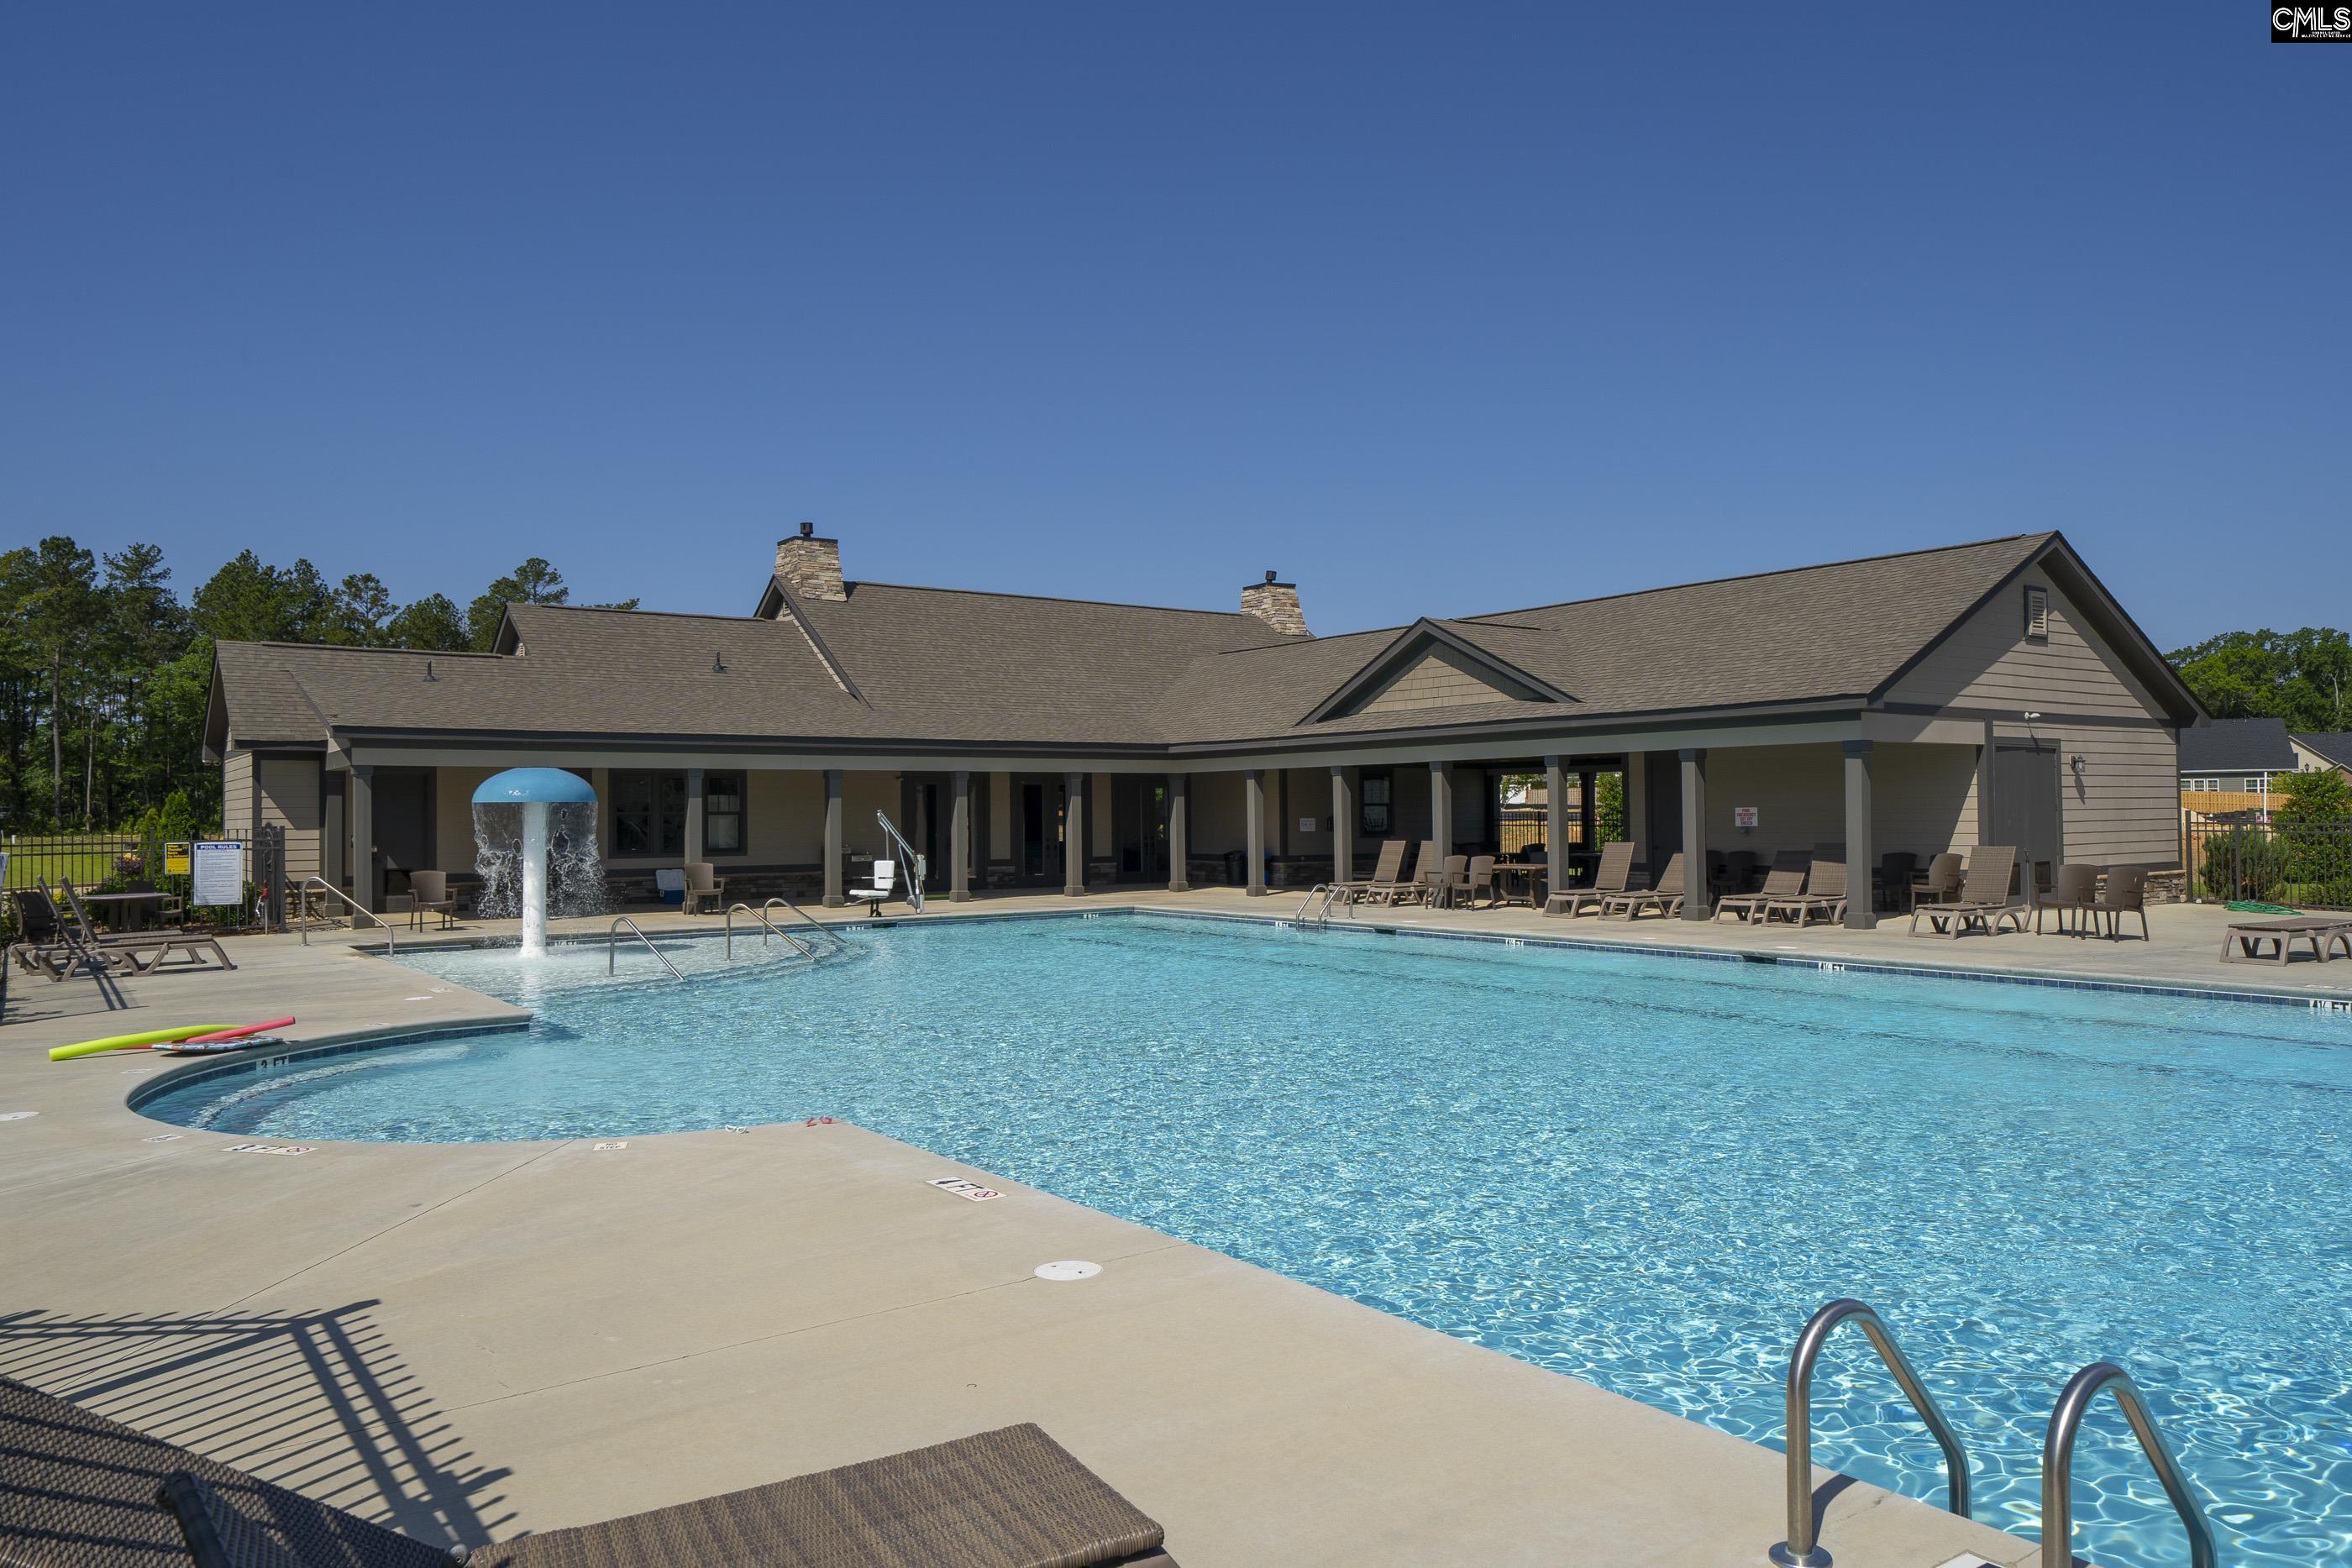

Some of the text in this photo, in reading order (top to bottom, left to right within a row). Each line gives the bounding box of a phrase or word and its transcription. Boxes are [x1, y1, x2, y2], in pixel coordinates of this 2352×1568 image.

[2331, 1000, 2349, 1011] FT
[273, 1055, 287, 1067] FT
[944, 1183, 985, 1193] FT
